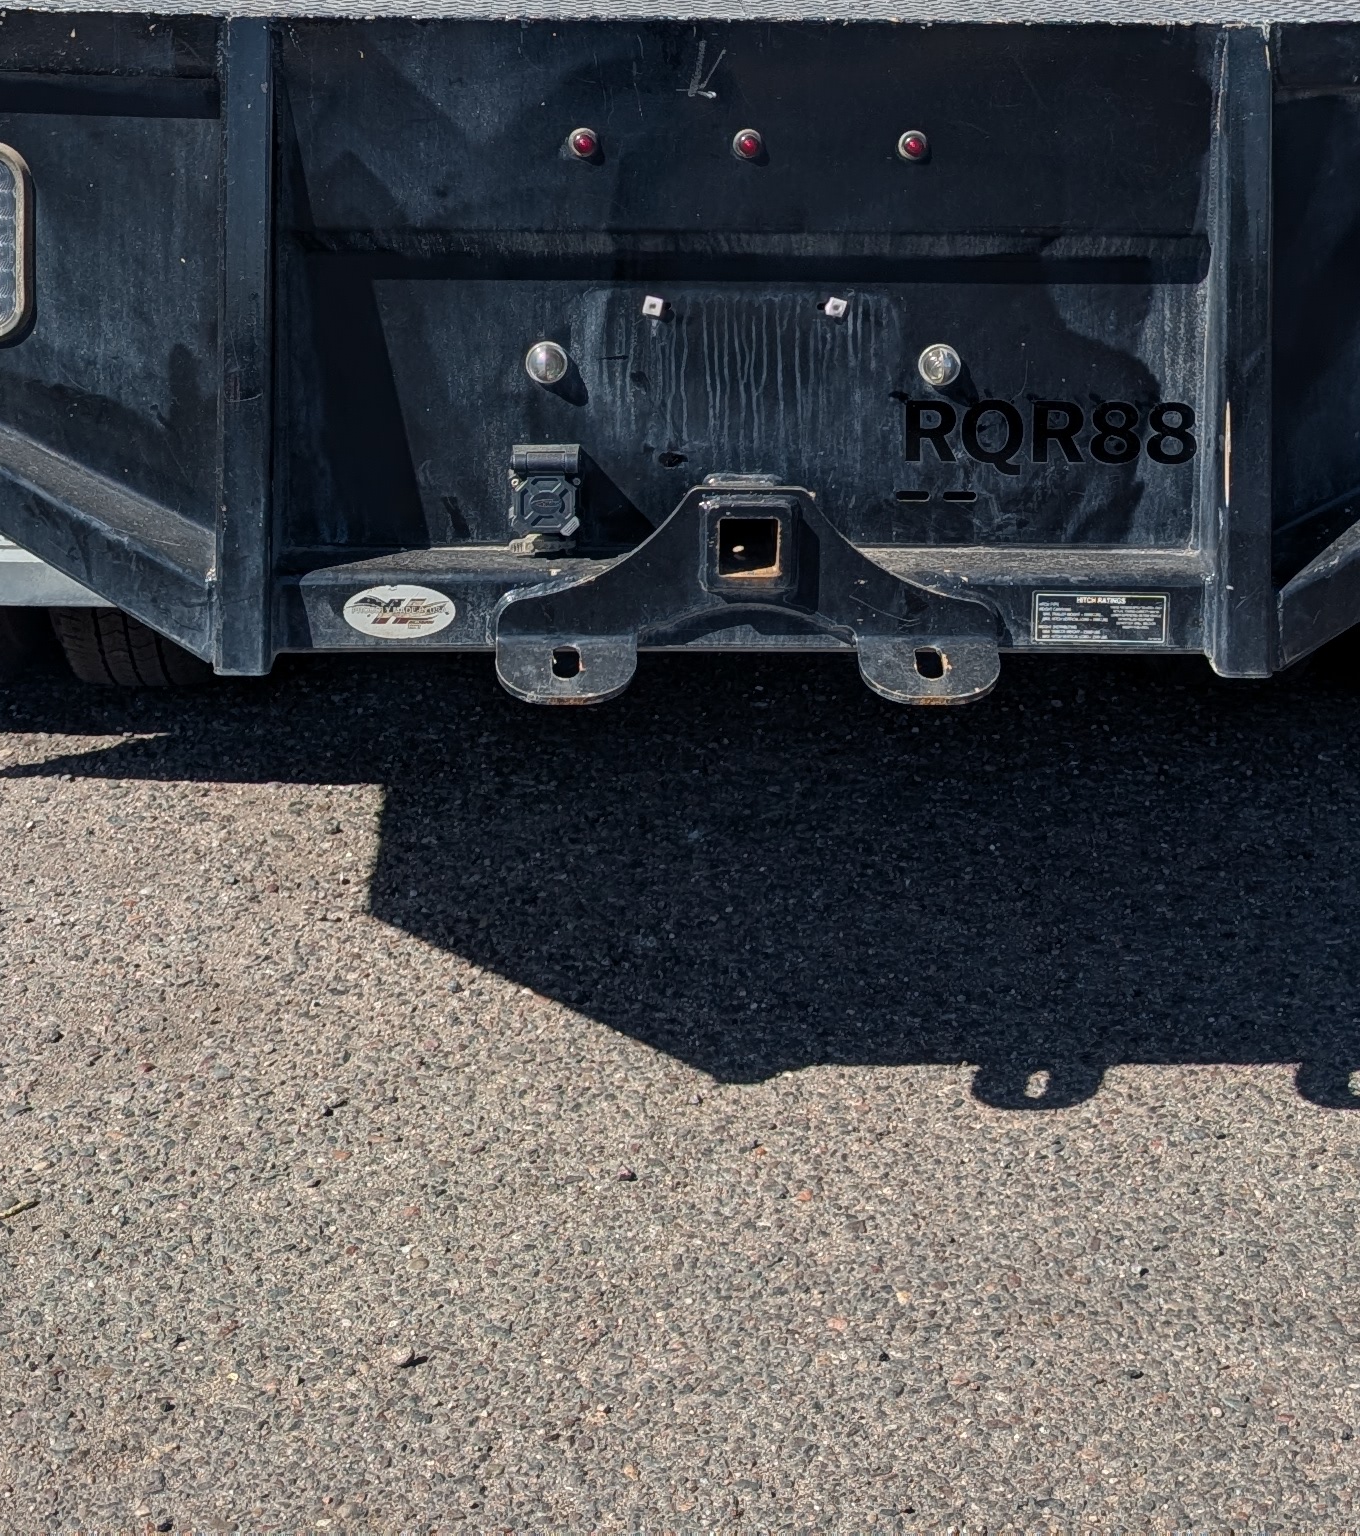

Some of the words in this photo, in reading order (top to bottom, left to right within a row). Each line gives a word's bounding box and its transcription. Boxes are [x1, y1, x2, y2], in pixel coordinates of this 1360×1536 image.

[905, 400, 1198, 476] RQR88
[1076, 596, 1097, 604] HITCH
[1097, 597, 1127, 605] RATINGS
